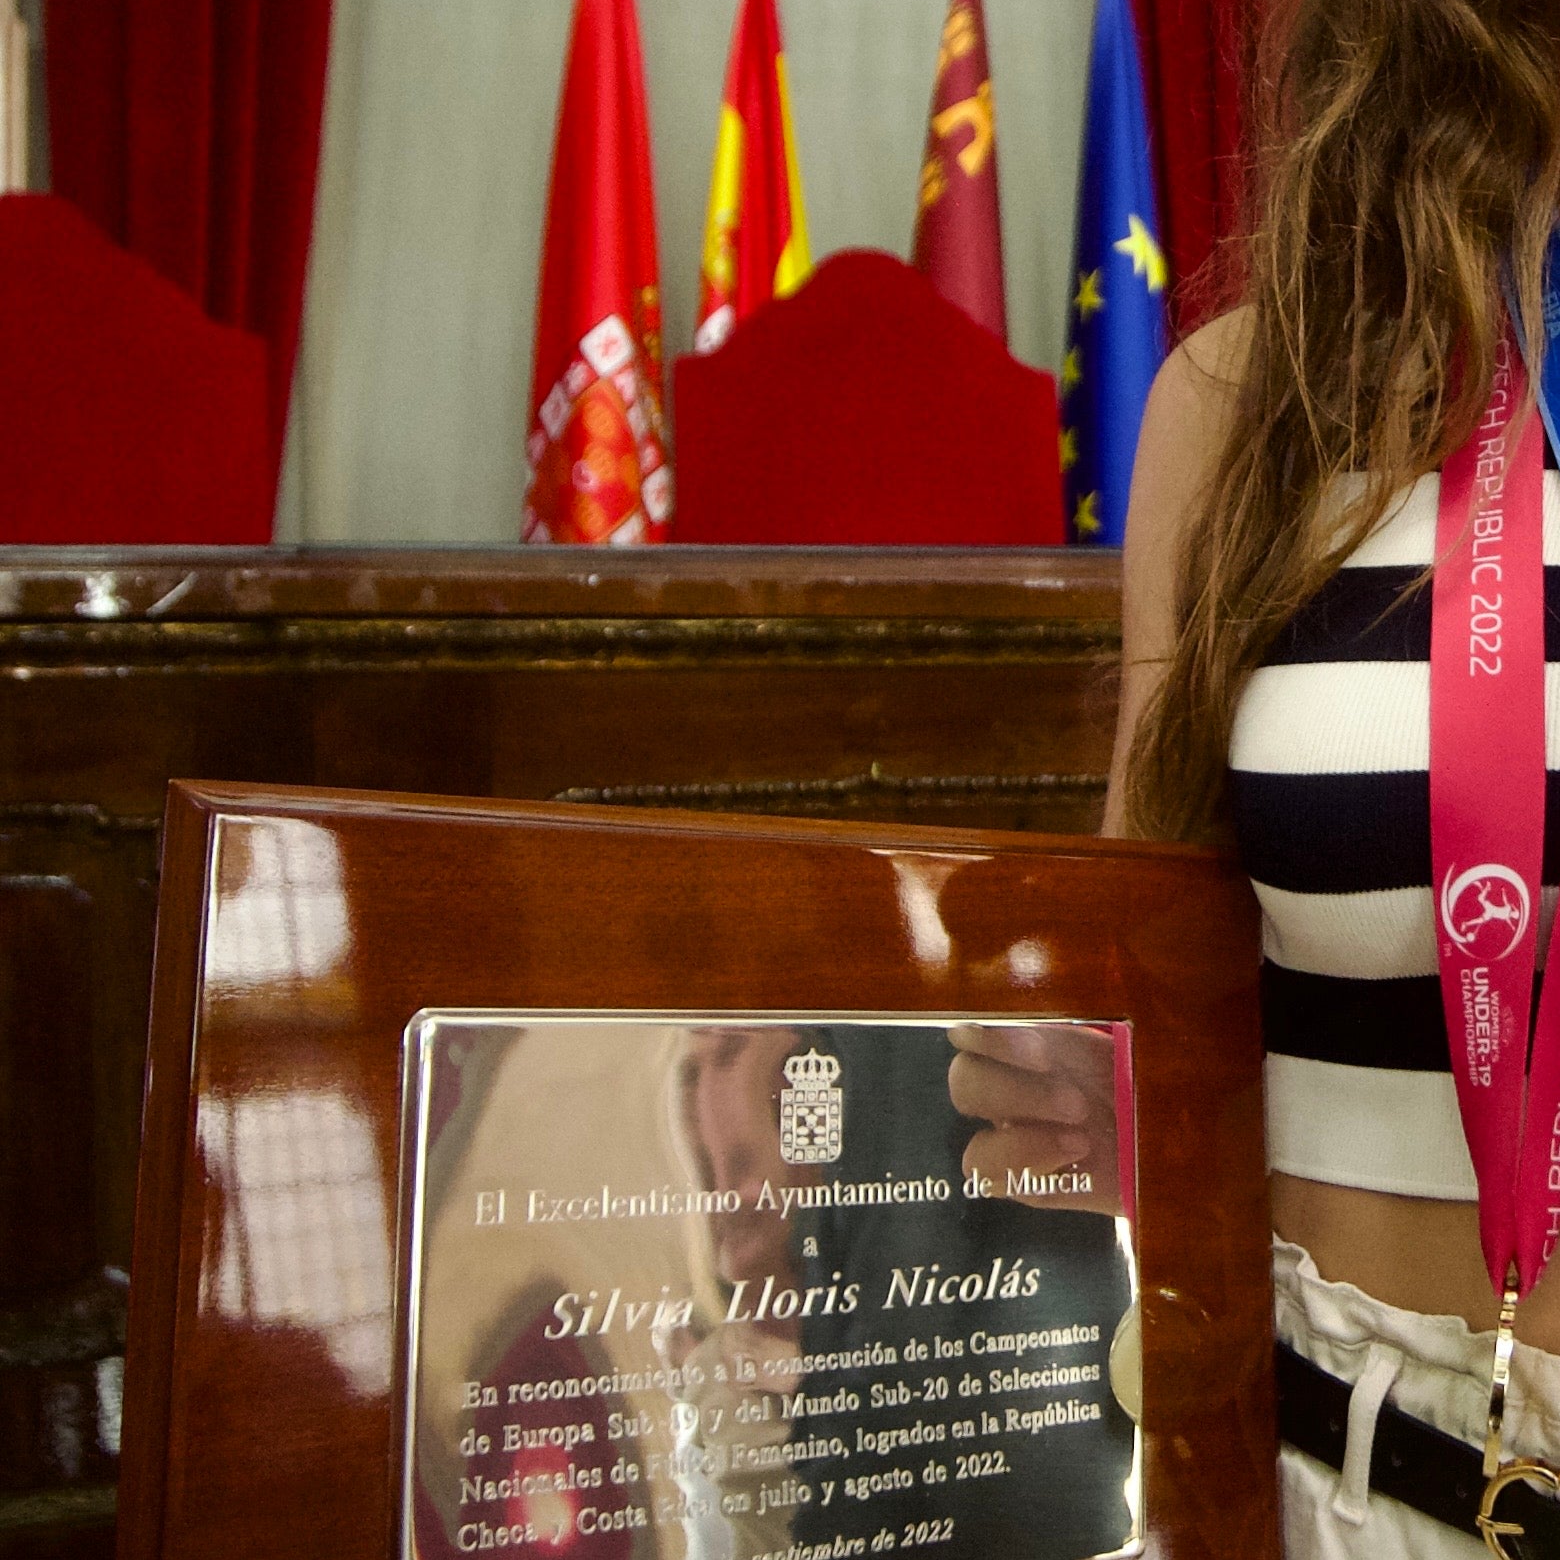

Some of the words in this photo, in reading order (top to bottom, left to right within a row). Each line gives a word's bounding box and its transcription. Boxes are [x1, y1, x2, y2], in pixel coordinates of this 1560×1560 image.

[1469, 594, 1502, 677] 2022
[1460, 968, 1479, 1087] CHAMPIONSHIP
[1472, 966, 1492, 1088] UNDER-19
[1490, 990, 1500, 1062] WOMEN'S
[476, 1188, 505, 1225] El
[526, 1183, 741, 1222] Excelentísimo
[755, 1171, 951, 1219] Ayuntamiento
[962, 1167, 993, 1199] de
[1005, 1163, 1093, 1197] Murcia
[802, 1236, 819, 1259] a
[543, 1284, 694, 1340] Silvia
[722, 1272, 861, 1324] Lloris
[881, 1257, 1042, 1311] Nicolás
[461, 1381, 500, 1410] En
[507, 1362, 706, 1403] reconocimiento
[714, 1363, 728, 1381] a
[735, 1352, 757, 1381] la
[762, 1343, 898, 1375] consecución
[903, 1337, 928, 1362] de
[934, 1335, 965, 1360] los
[969, 1323, 1101, 1356] Campeonatos
[459, 1463, 603, 1504] Nacionales
[609, 1457, 640, 1486] de
[731, 1434, 850, 1469] Femenino,
[856, 1420, 946, 1455] logrados
[951, 1419, 976, 1439] en
[980, 1411, 999, 1434] la
[1004, 1400, 1102, 1435] República
[460, 1428, 492, 1457] de
[502, 1422, 596, 1453] Europa
[709, 1407, 724, 1434] y
[735, 1396, 770, 1423] del
[780, 1387, 861, 1419] Mundo
[870, 1375, 949, 1409] Sub-20
[957, 1373, 982, 1398] de
[988, 1362, 1101, 1395] Selecciones
[457, 1521, 539, 1552] Checa
[576, 1504, 648, 1535] Costa
[721, 1493, 751, 1515] en
[755, 1478, 812, 1516] julio
[820, 1480, 835, 1506] y
[844, 1470, 914, 1501] agosto
[921, 1460, 947, 1484] de
[955, 1451, 1012, 1482] 2022.
[870, 1528, 896, 1553] de
[900, 1517, 955, 1547] 2022
